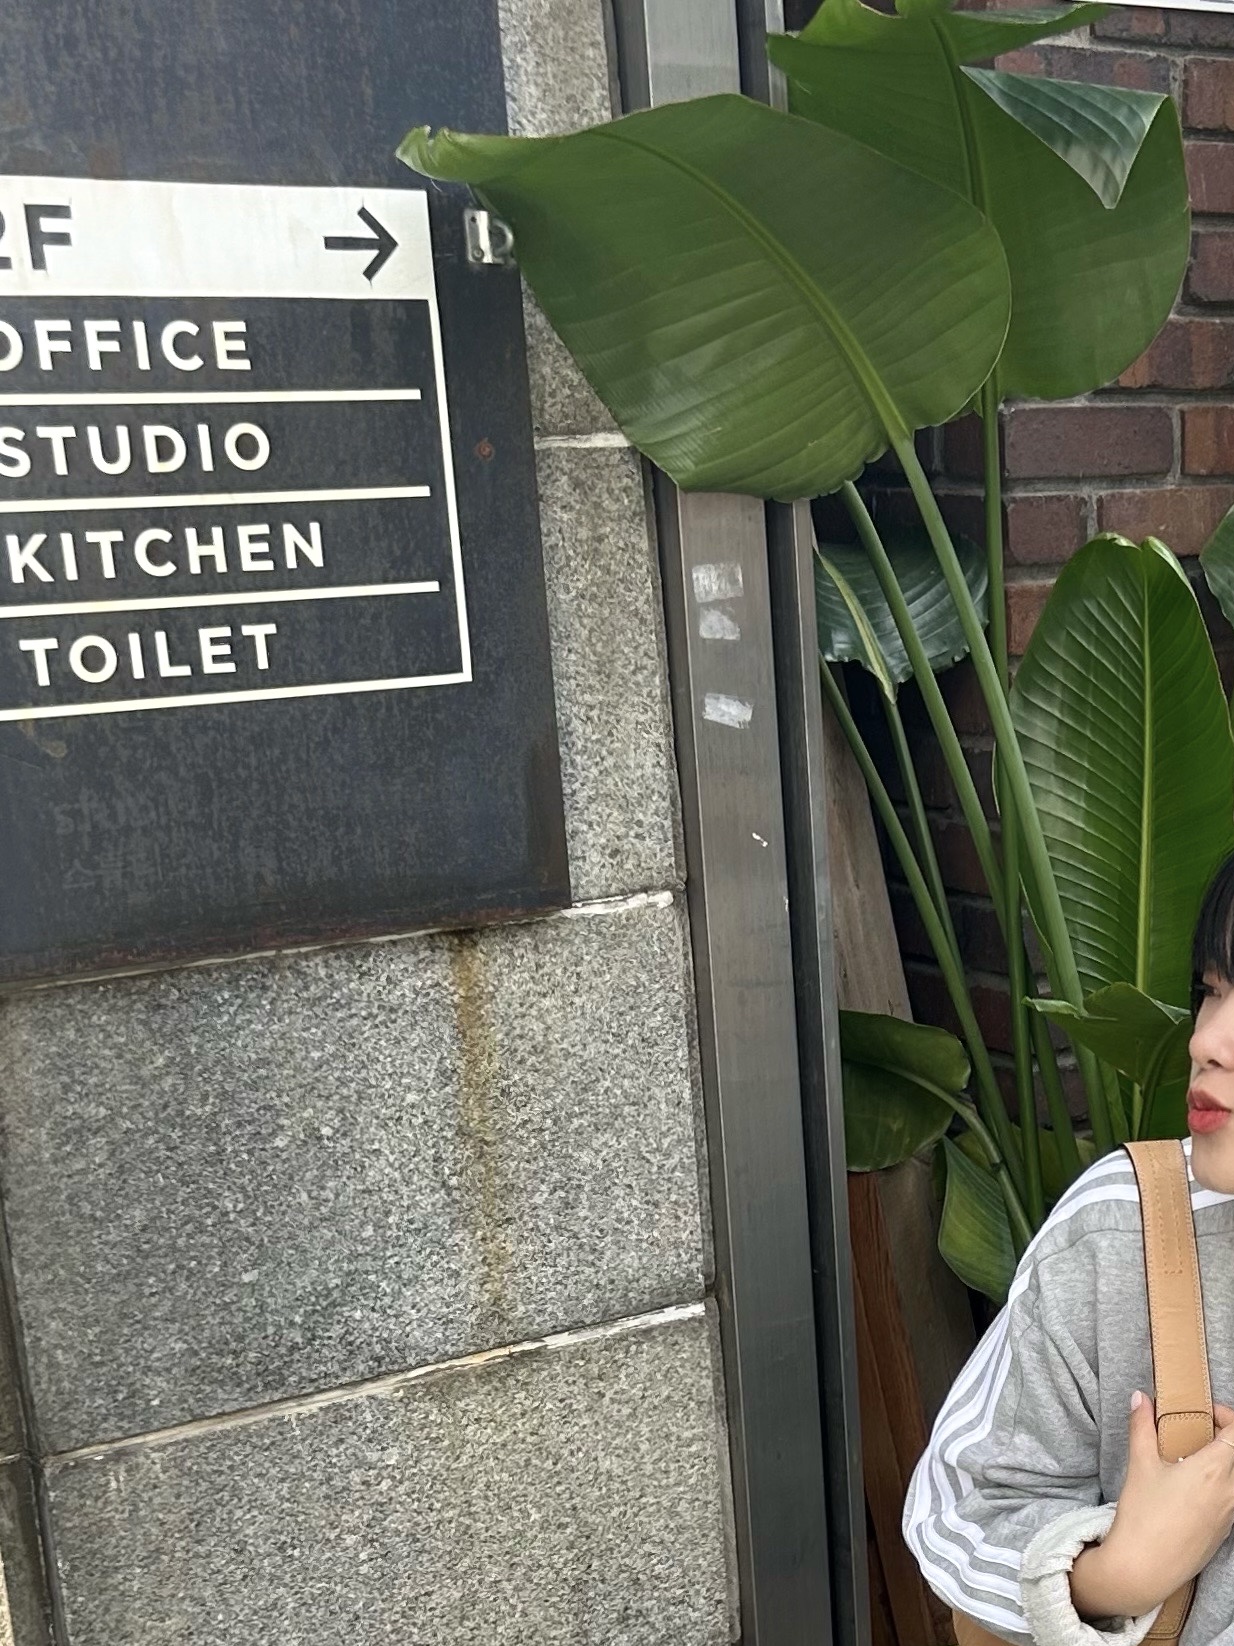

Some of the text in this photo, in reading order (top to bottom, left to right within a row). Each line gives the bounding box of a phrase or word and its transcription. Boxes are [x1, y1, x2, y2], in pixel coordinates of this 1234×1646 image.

[0, 203, 72, 270] F
[0, 422, 270, 478] STUDIO
[6, 521, 325, 584] KITCHEN
[18, 623, 278, 687] TOILET
